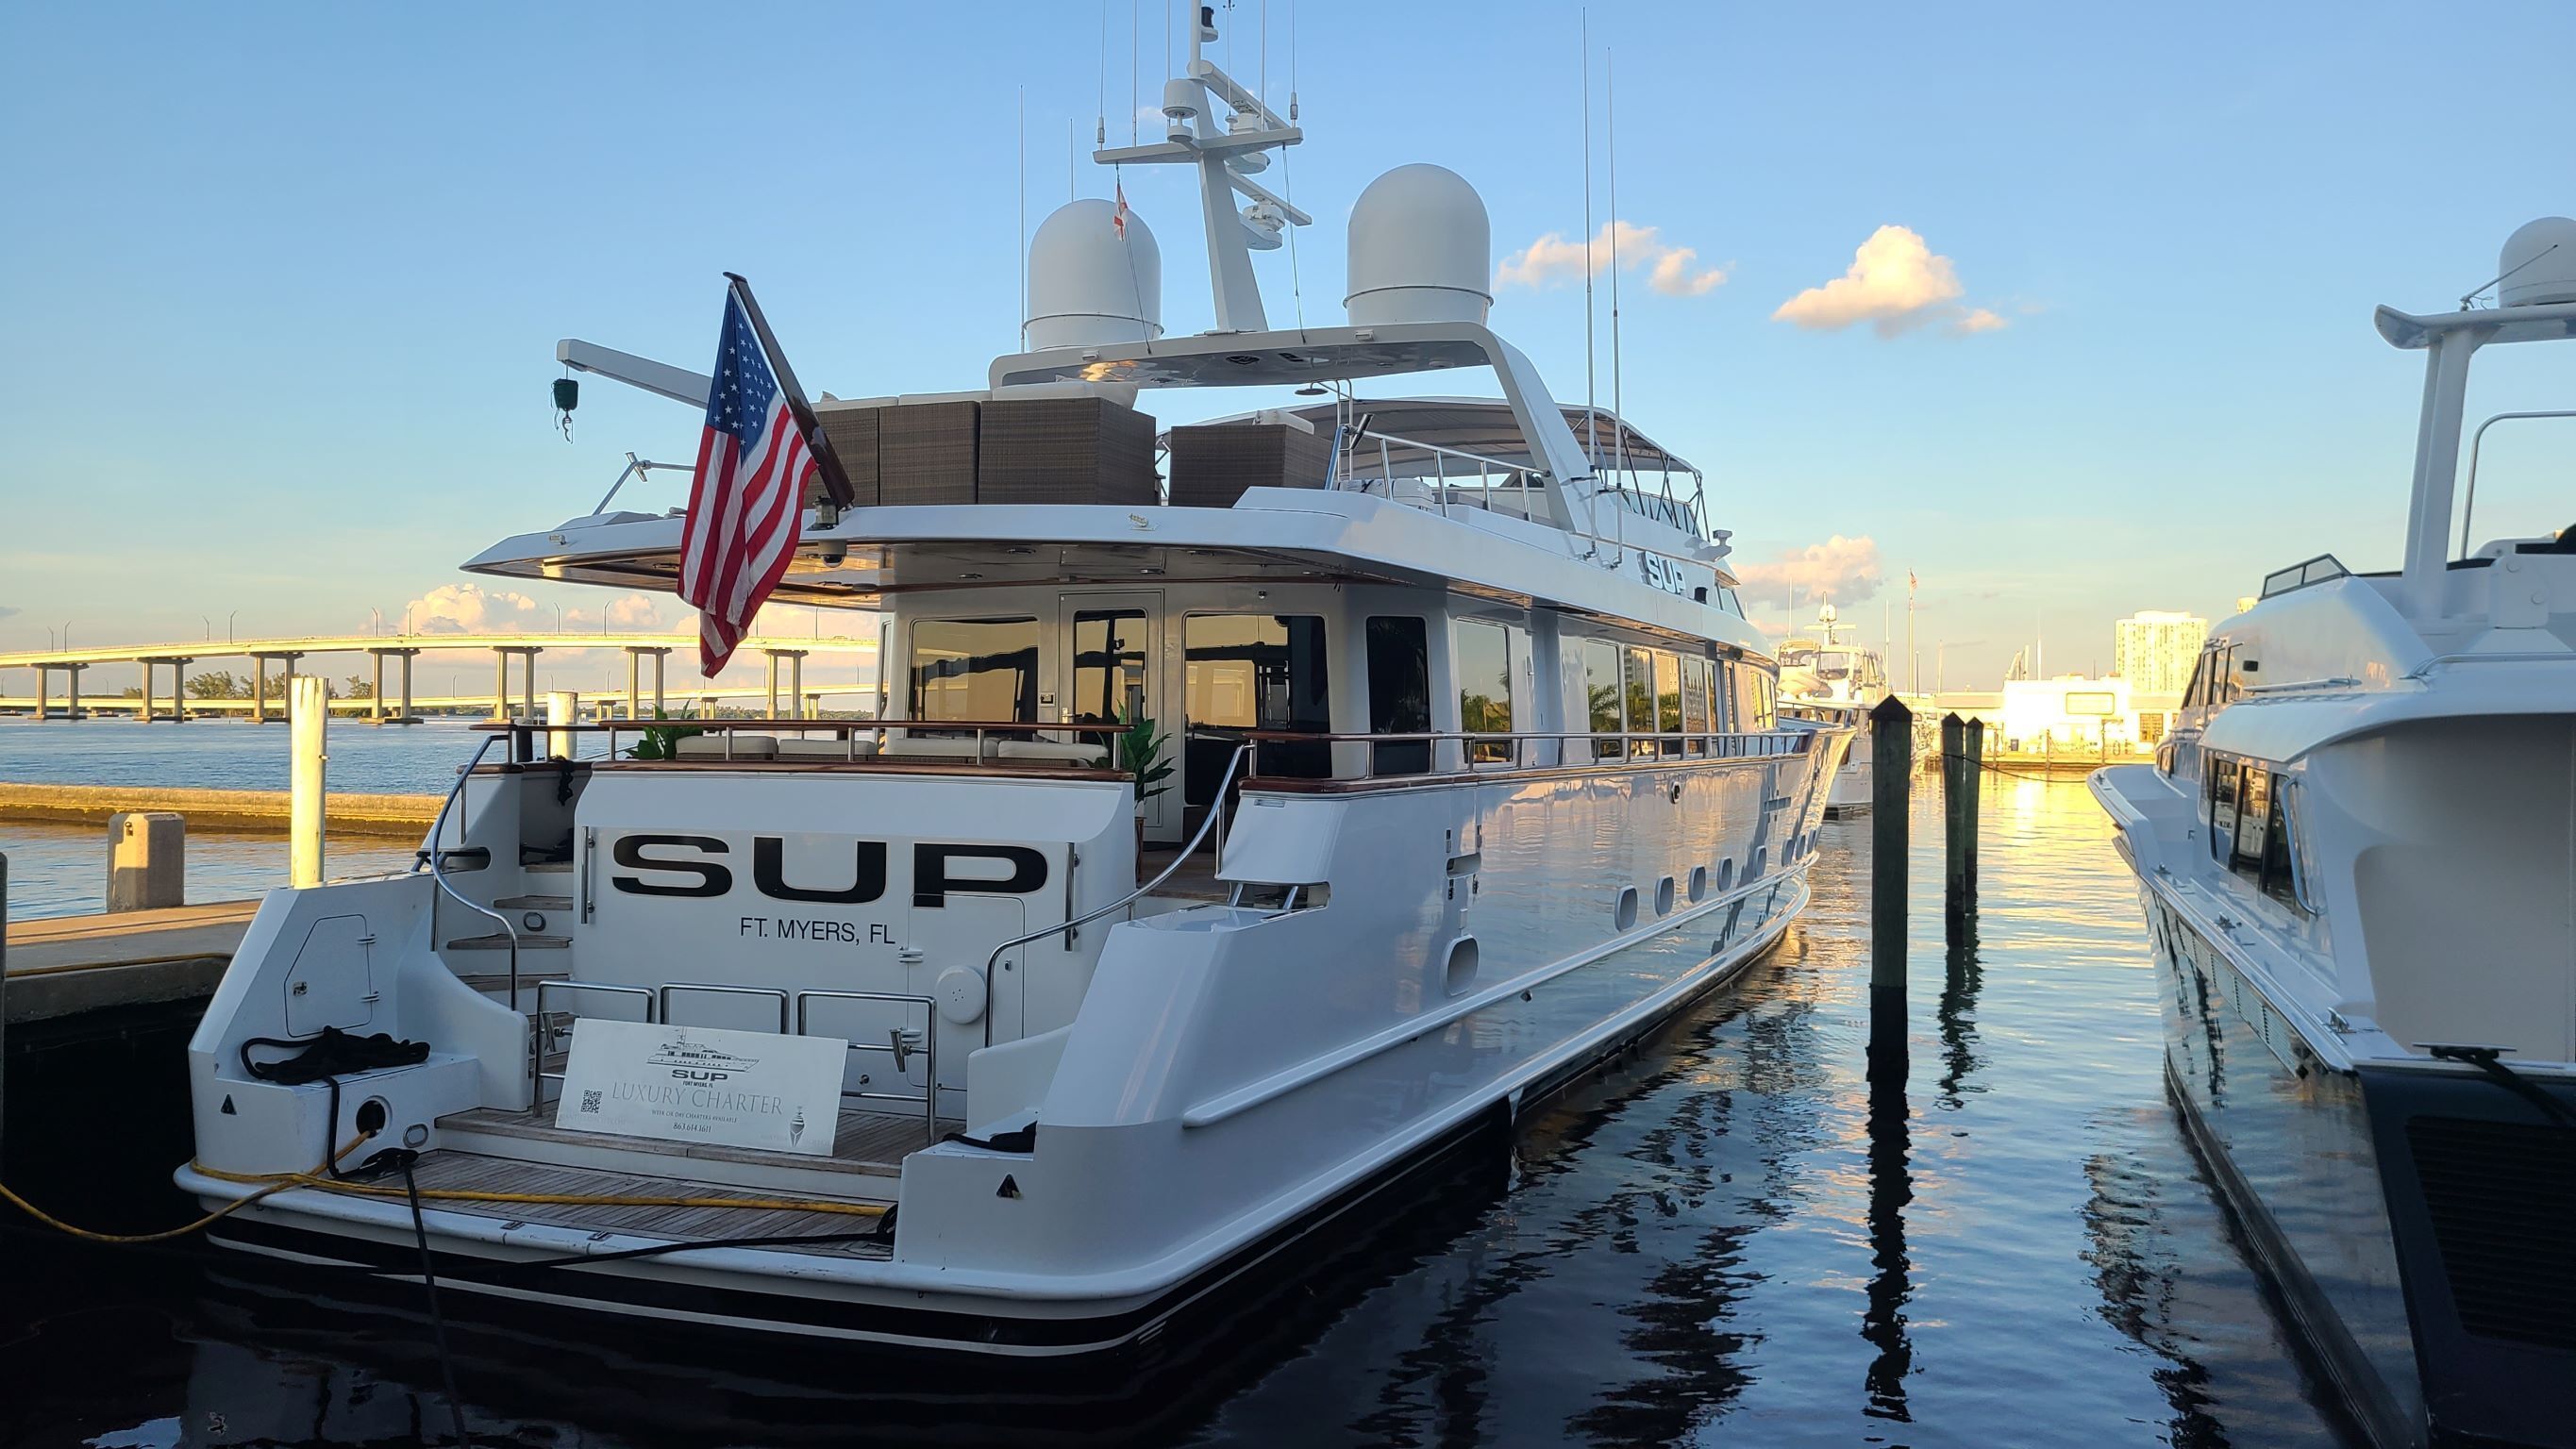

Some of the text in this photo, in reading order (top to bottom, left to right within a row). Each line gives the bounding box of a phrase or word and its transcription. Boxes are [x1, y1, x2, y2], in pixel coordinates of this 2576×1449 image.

[1640, 551, 1686, 595] SUP
[611, 834, 1048, 908] SUP
[740, 917, 895, 947] FT. MYERS, FL
[671, 1069, 728, 1082] SUP
[611, 1080, 783, 1115] LUXURY CHARTER
